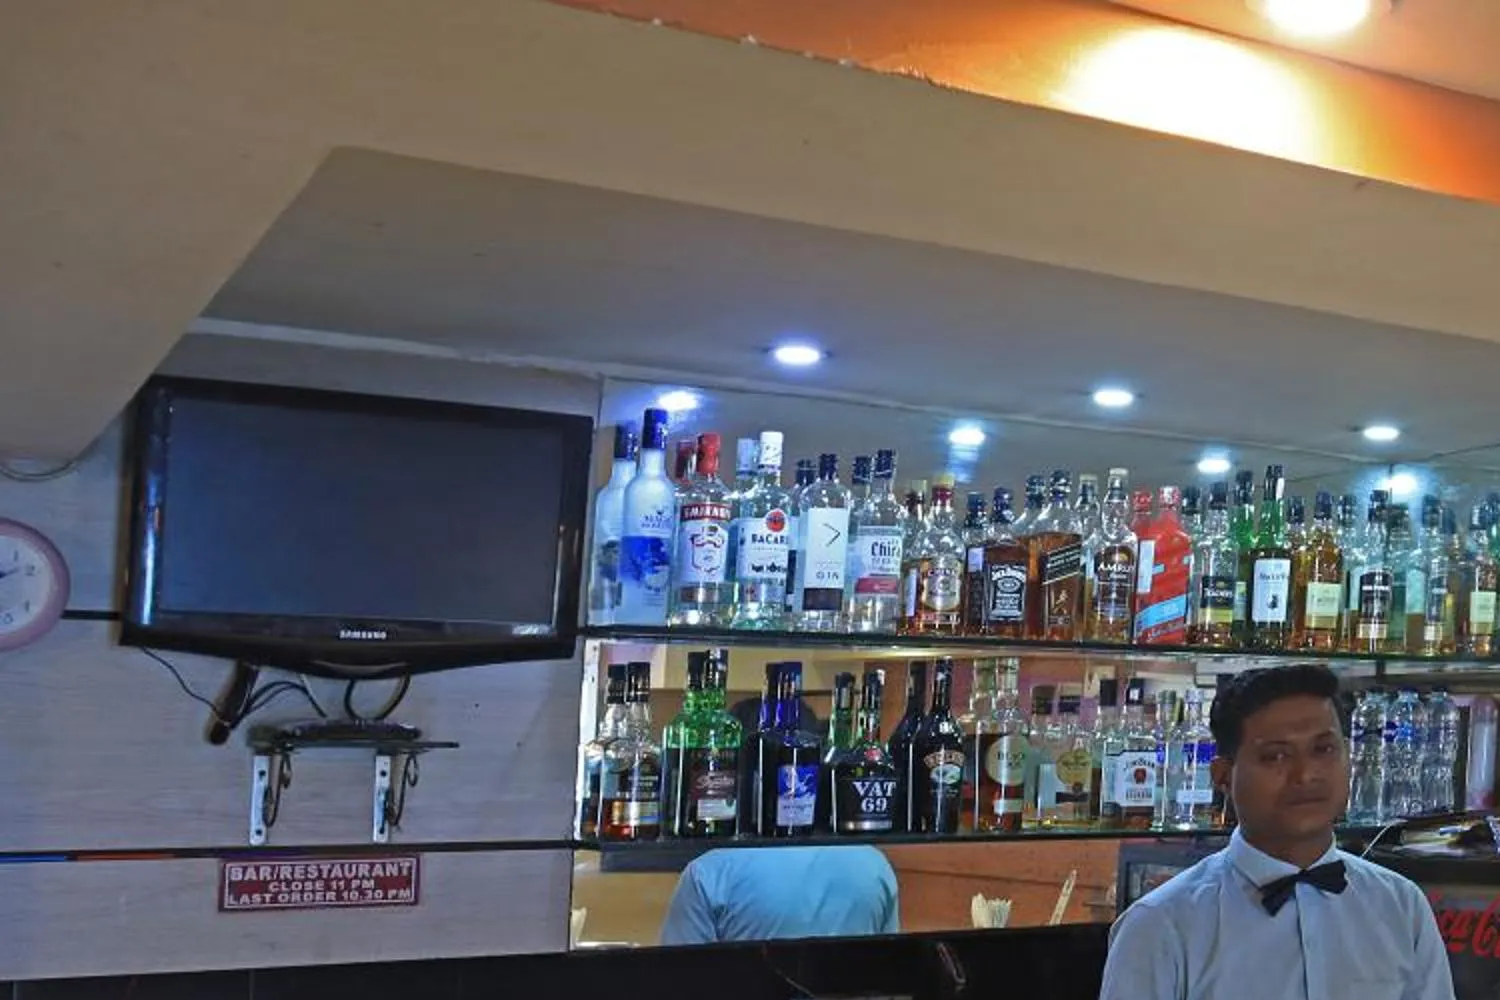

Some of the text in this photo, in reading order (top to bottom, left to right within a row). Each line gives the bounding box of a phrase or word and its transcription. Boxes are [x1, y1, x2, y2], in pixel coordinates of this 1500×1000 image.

[853, 781, 896, 797] VAT
[861, 797, 888, 813] 69
[230, 862, 411, 881] BAR/RESTAURANT
[268, 878, 375, 893] CLOSE 11 PM
[228, 893, 273, 905] LAST
[278, 891, 336, 902] ORDER
[387, 888, 411, 899] PM
